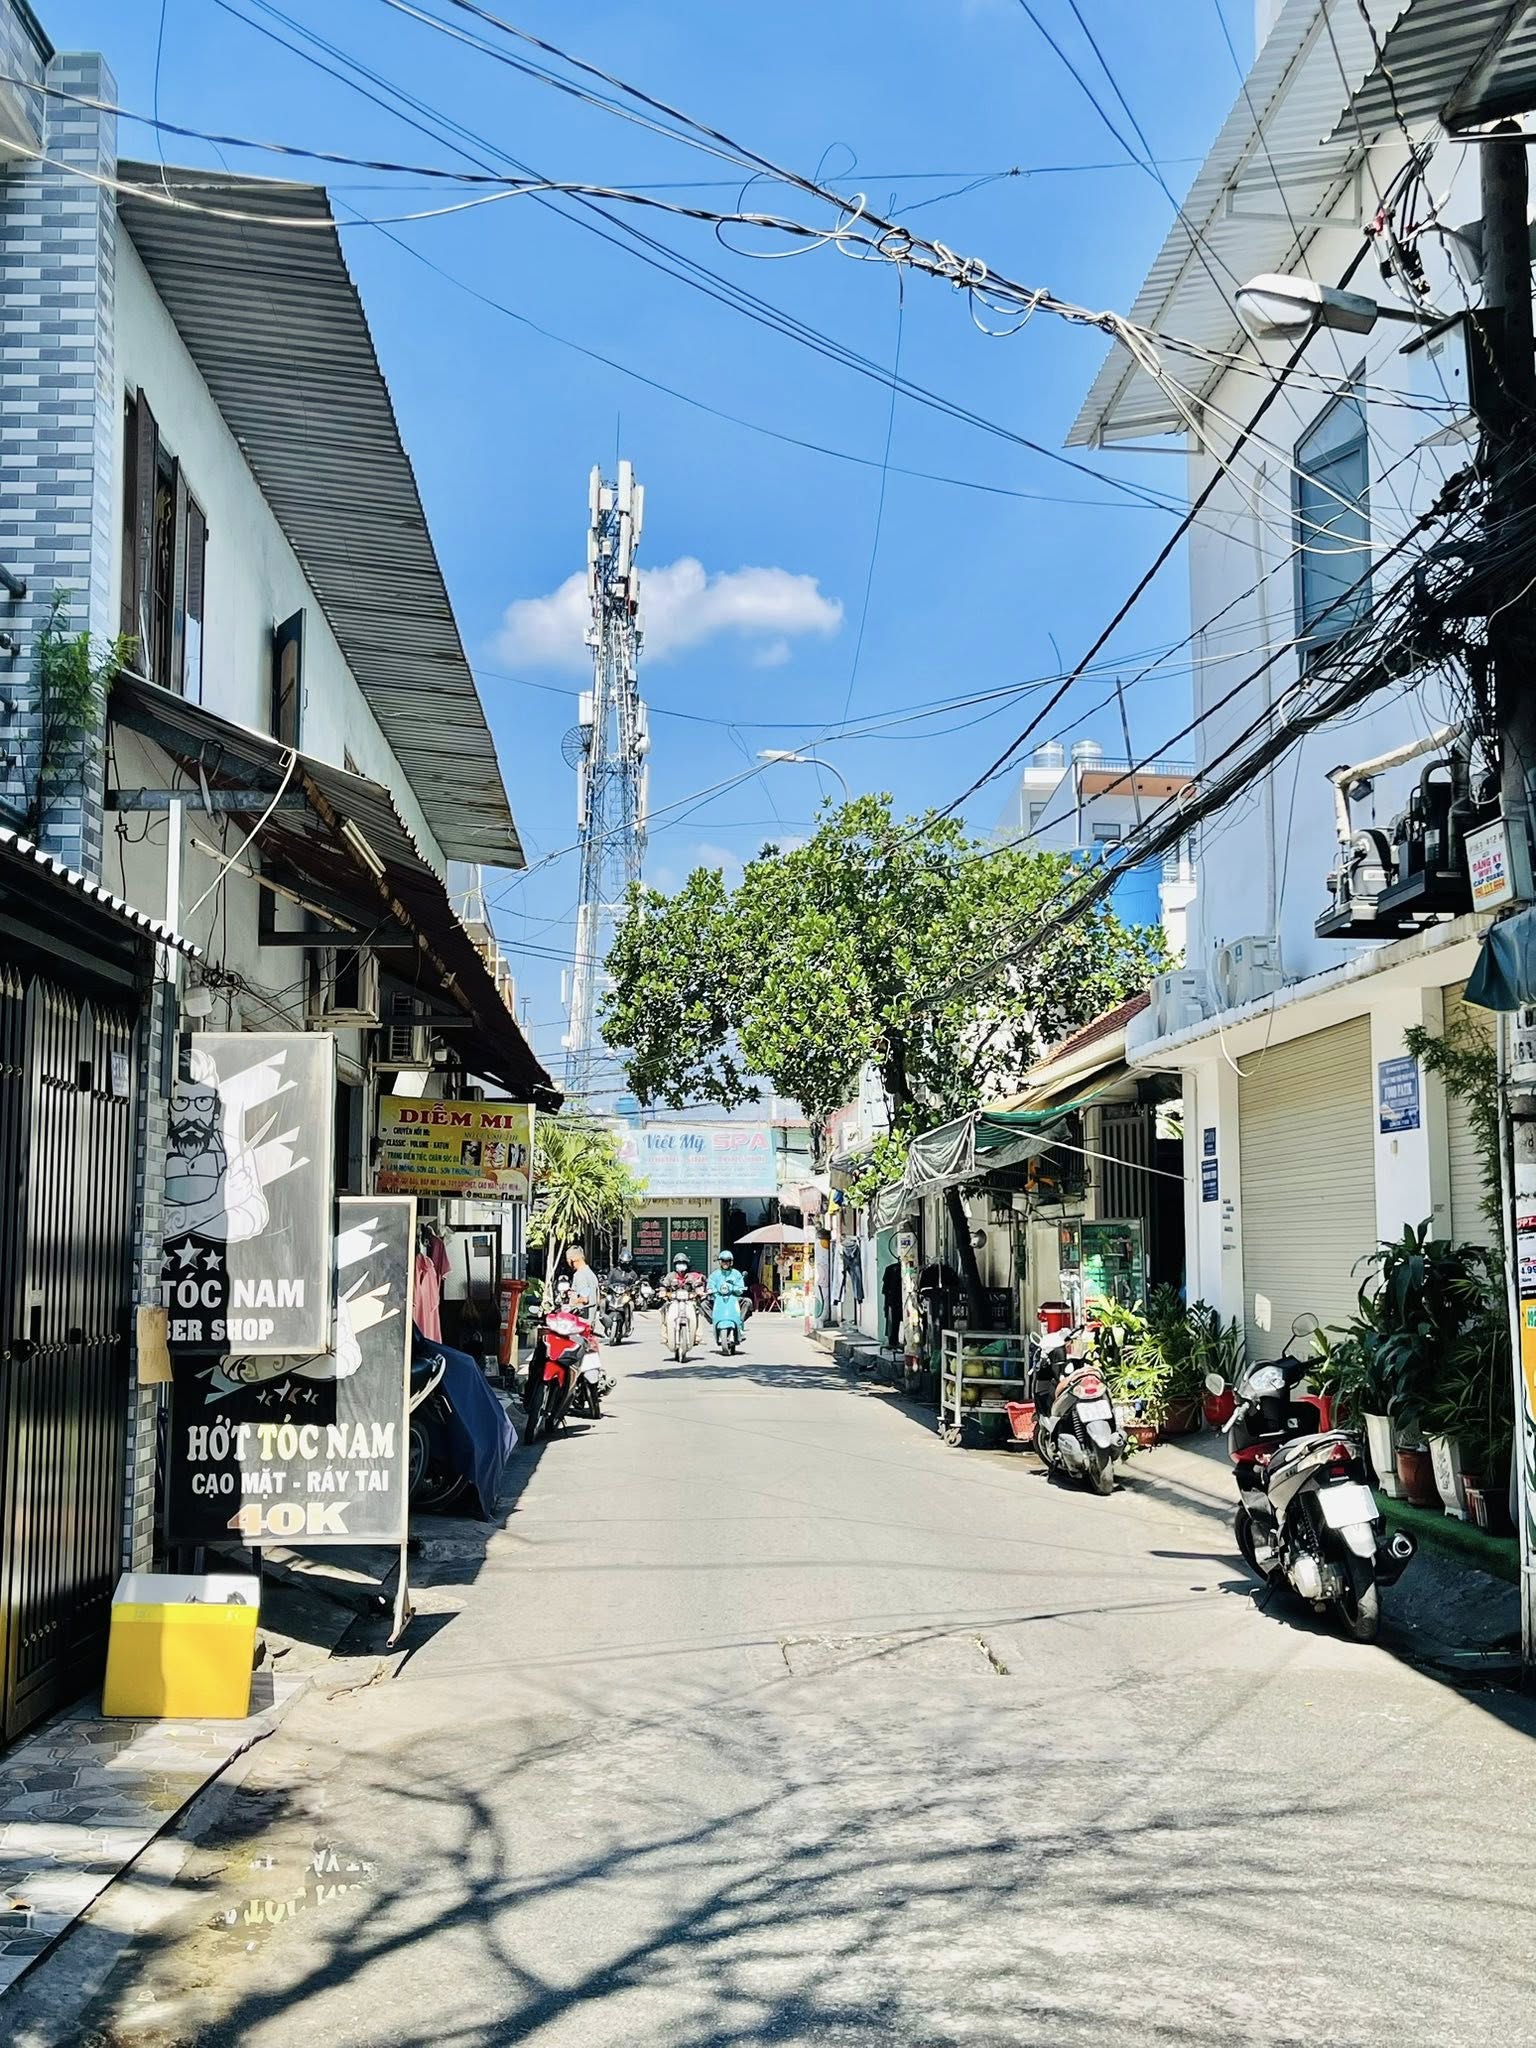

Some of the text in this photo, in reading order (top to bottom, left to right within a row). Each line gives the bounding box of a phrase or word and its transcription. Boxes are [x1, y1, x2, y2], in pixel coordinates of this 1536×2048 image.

[398, 1103, 513, 1129] DIỄM MI
[679, 1134, 706, 1153] Mỹ
[712, 1133, 769, 1151] SPA
[160, 1272, 305, 1309] TÓC NAM
[211, 1318, 275, 1341] SHOP
[187, 1414, 395, 1461] HỚT TÓC NAM
[192, 1472, 234, 1499] CẠO
[241, 1468, 287, 1499] MẶT
[307, 1465, 350, 1493] RÁY
[355, 1470, 389, 1492] TAI
[227, 1502, 351, 1536] 40K
